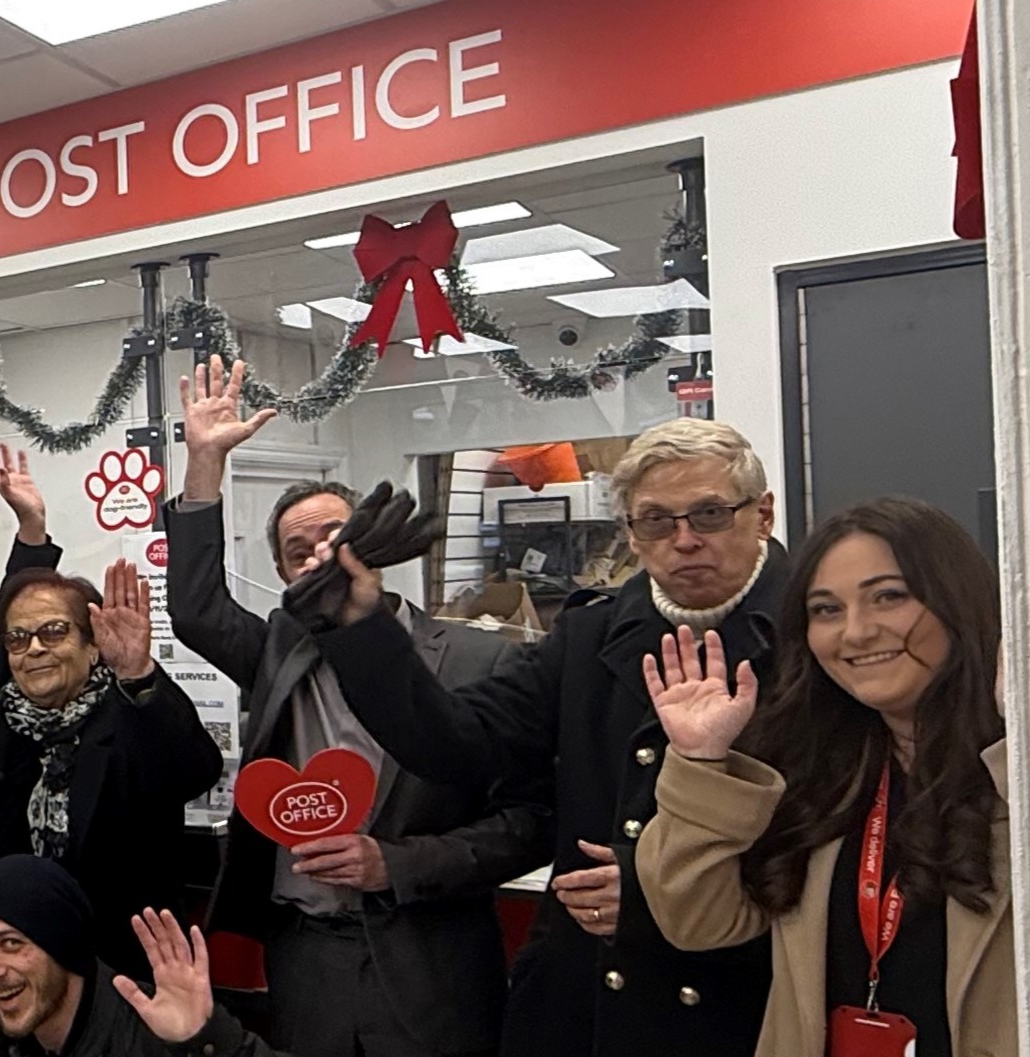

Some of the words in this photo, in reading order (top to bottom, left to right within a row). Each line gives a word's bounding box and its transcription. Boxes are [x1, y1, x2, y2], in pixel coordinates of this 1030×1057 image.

[172, 29, 507, 178] OFFICE
[175, 673, 217, 681] SERVICES
[286, 791, 328, 809] POST
[280, 804, 338, 824] OFFICE
[872, 816, 882, 834] We
[866, 836, 880, 874] deliver
